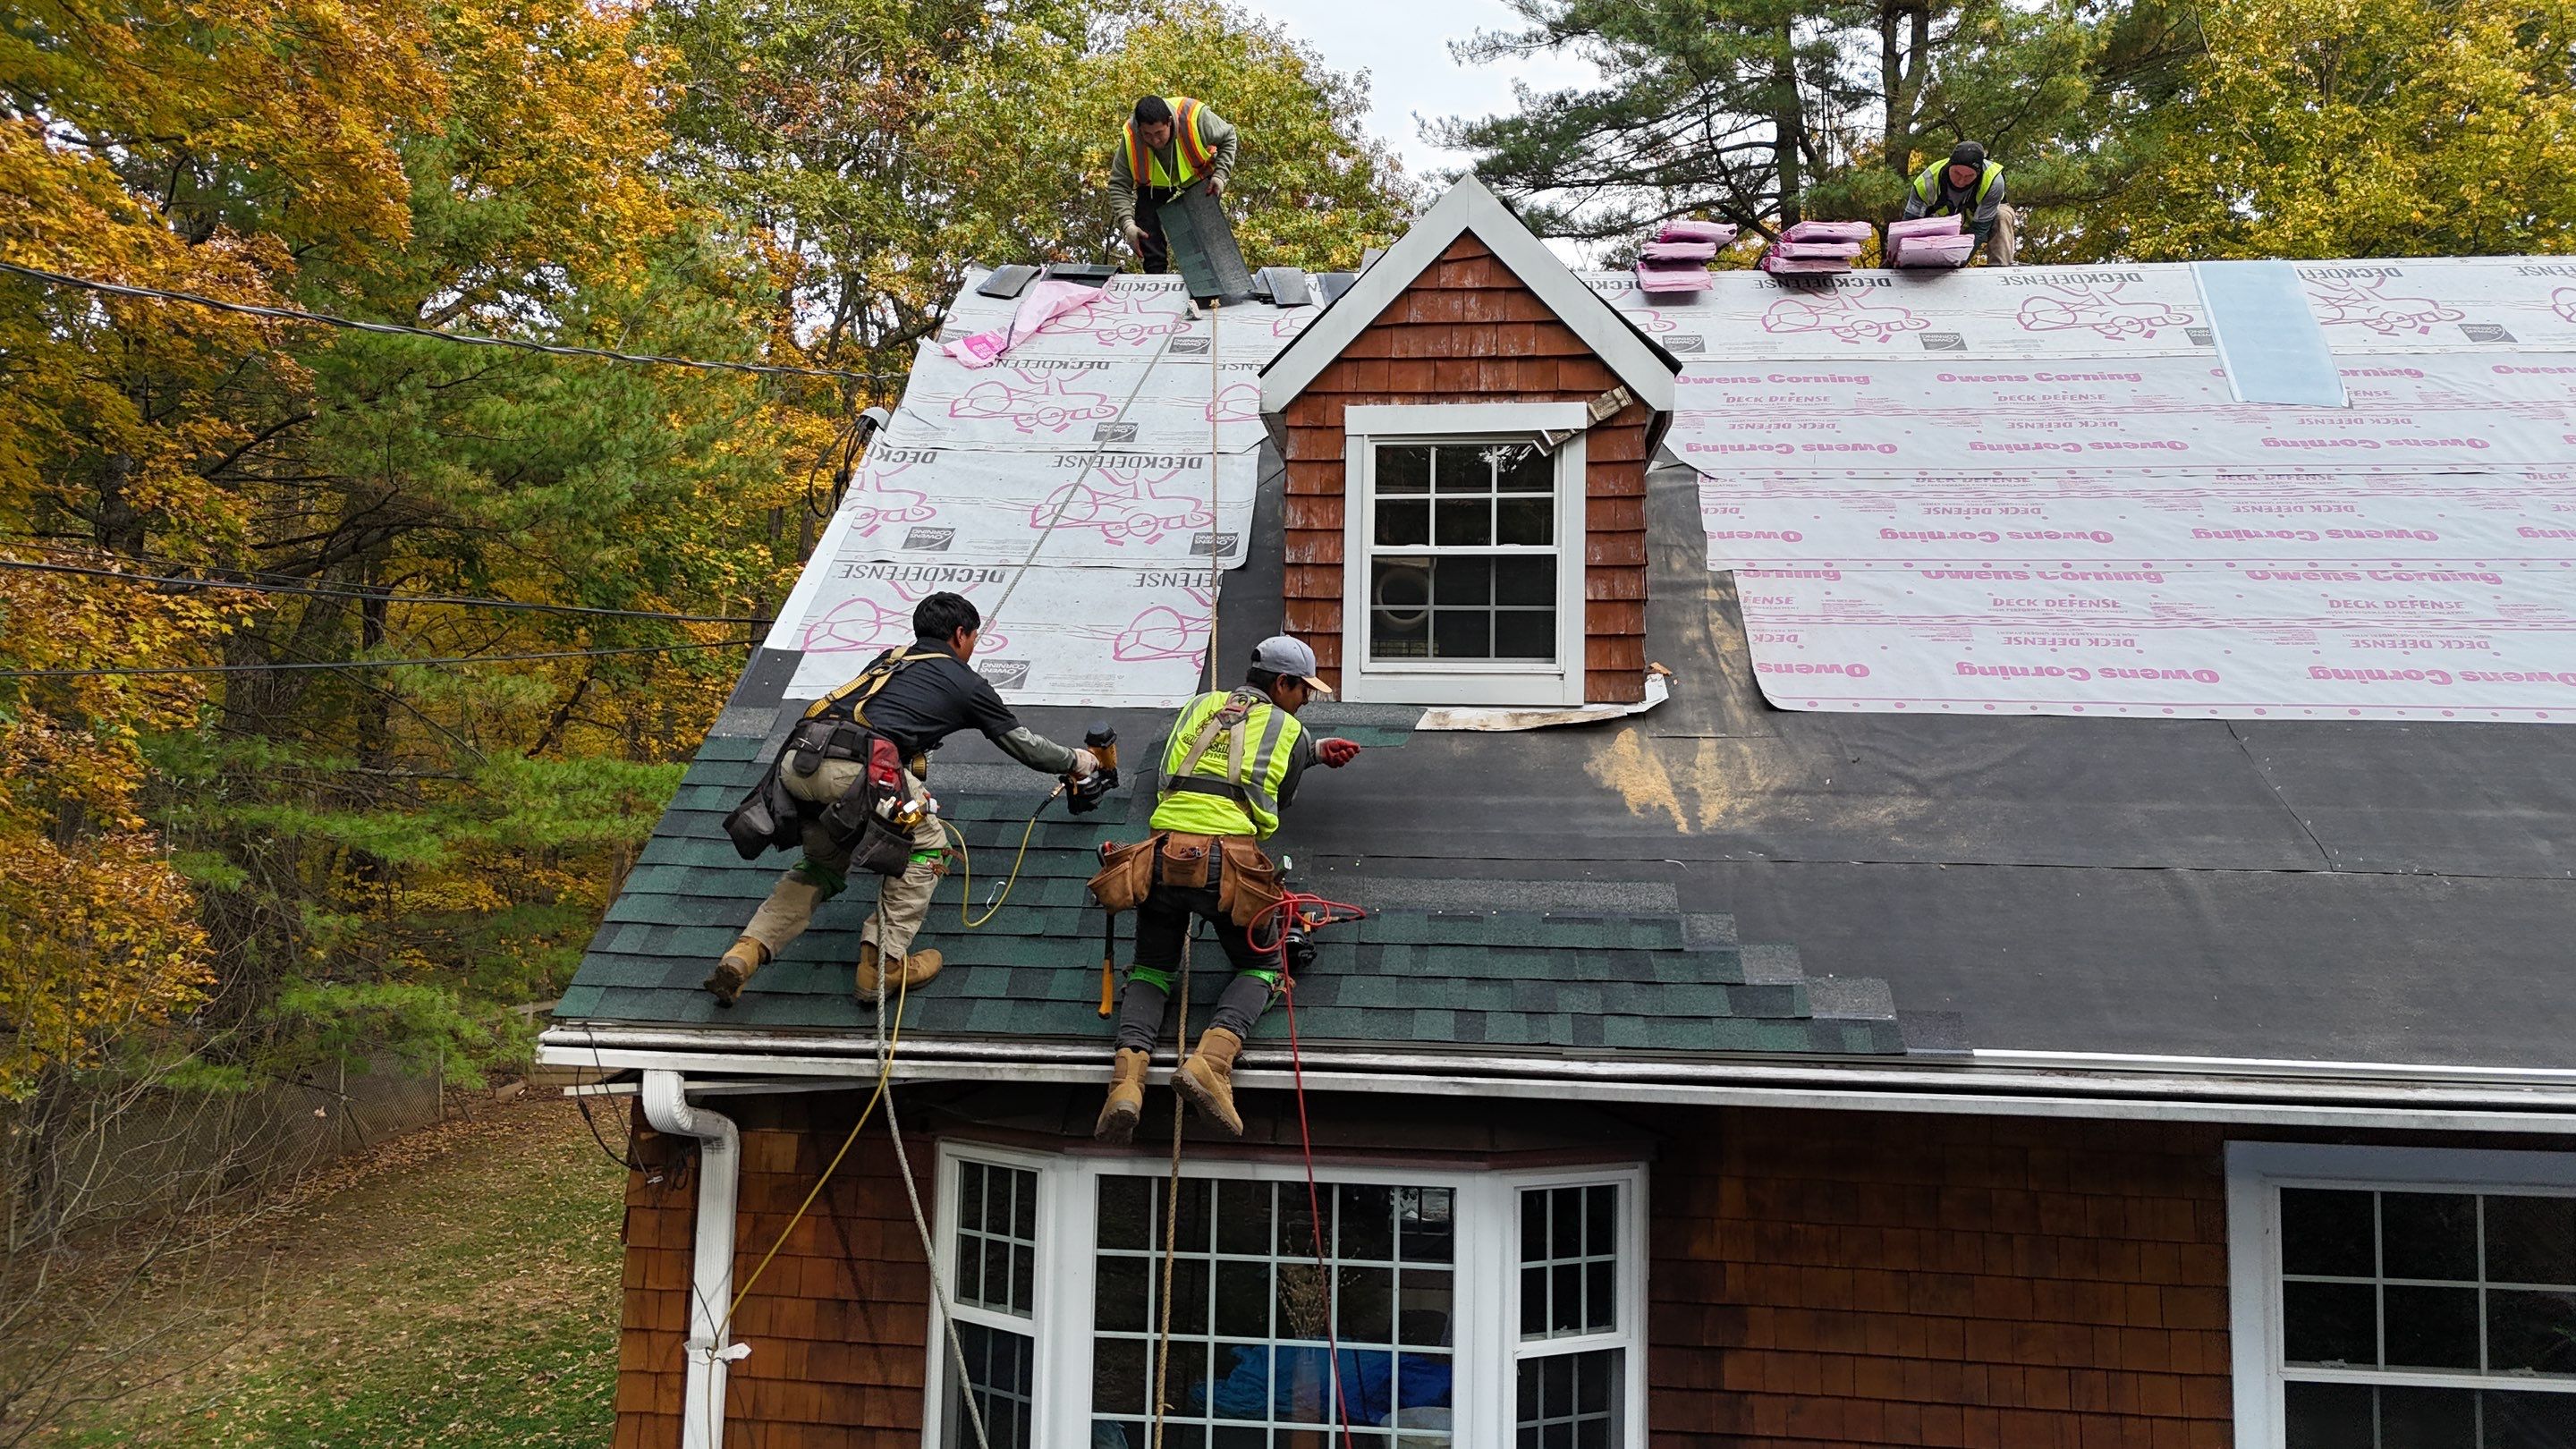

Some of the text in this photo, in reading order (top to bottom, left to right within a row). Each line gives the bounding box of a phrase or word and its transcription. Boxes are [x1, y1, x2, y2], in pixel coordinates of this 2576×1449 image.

[1753, 277, 1892, 289] DECKDEFENSE
[1999, 273, 2143, 286] DECKDEFENSE
[1675, 373, 1870, 386] Owens Corning
[1936, 372, 2143, 384] Owens Corning
[1726, 394, 1831, 403] DECK DEFENSE
[1997, 394, 2106, 402] DECK DEFENSE
[1728, 422, 1792, 430] DEFENSE
[2007, 421, 2073, 429] DEFENSE
[2298, 417, 2364, 425] DEFENSE
[1685, 443, 1898, 454] Owens Corning
[1969, 441, 2190, 453] Owens Corning
[2261, 436, 2491, 449] Owens Corning
[1924, 507, 1992, 515] DEFENSE
[2233, 504, 2355, 513] DECK DEFENSE
[1879, 528, 2114, 543] Owens Corning
[2191, 528, 2440, 542] Owens Corning
[838, 564, 1006, 583] DECKDEFENSE
[1993, 598, 2121, 608] DECK DEFENSE
[2329, 599, 2466, 609] DECK DEFENSE
[1754, 634, 1799, 642] DECK
[2003, 636, 2136, 648] DECK DEFENSE
[2349, 639, 2490, 649] DECK DEFENSE
[1756, 662, 1870, 677] Owens
[1955, 662, 2220, 683] Owens Corning
[2308, 665, 2576, 687] Owens Corning
